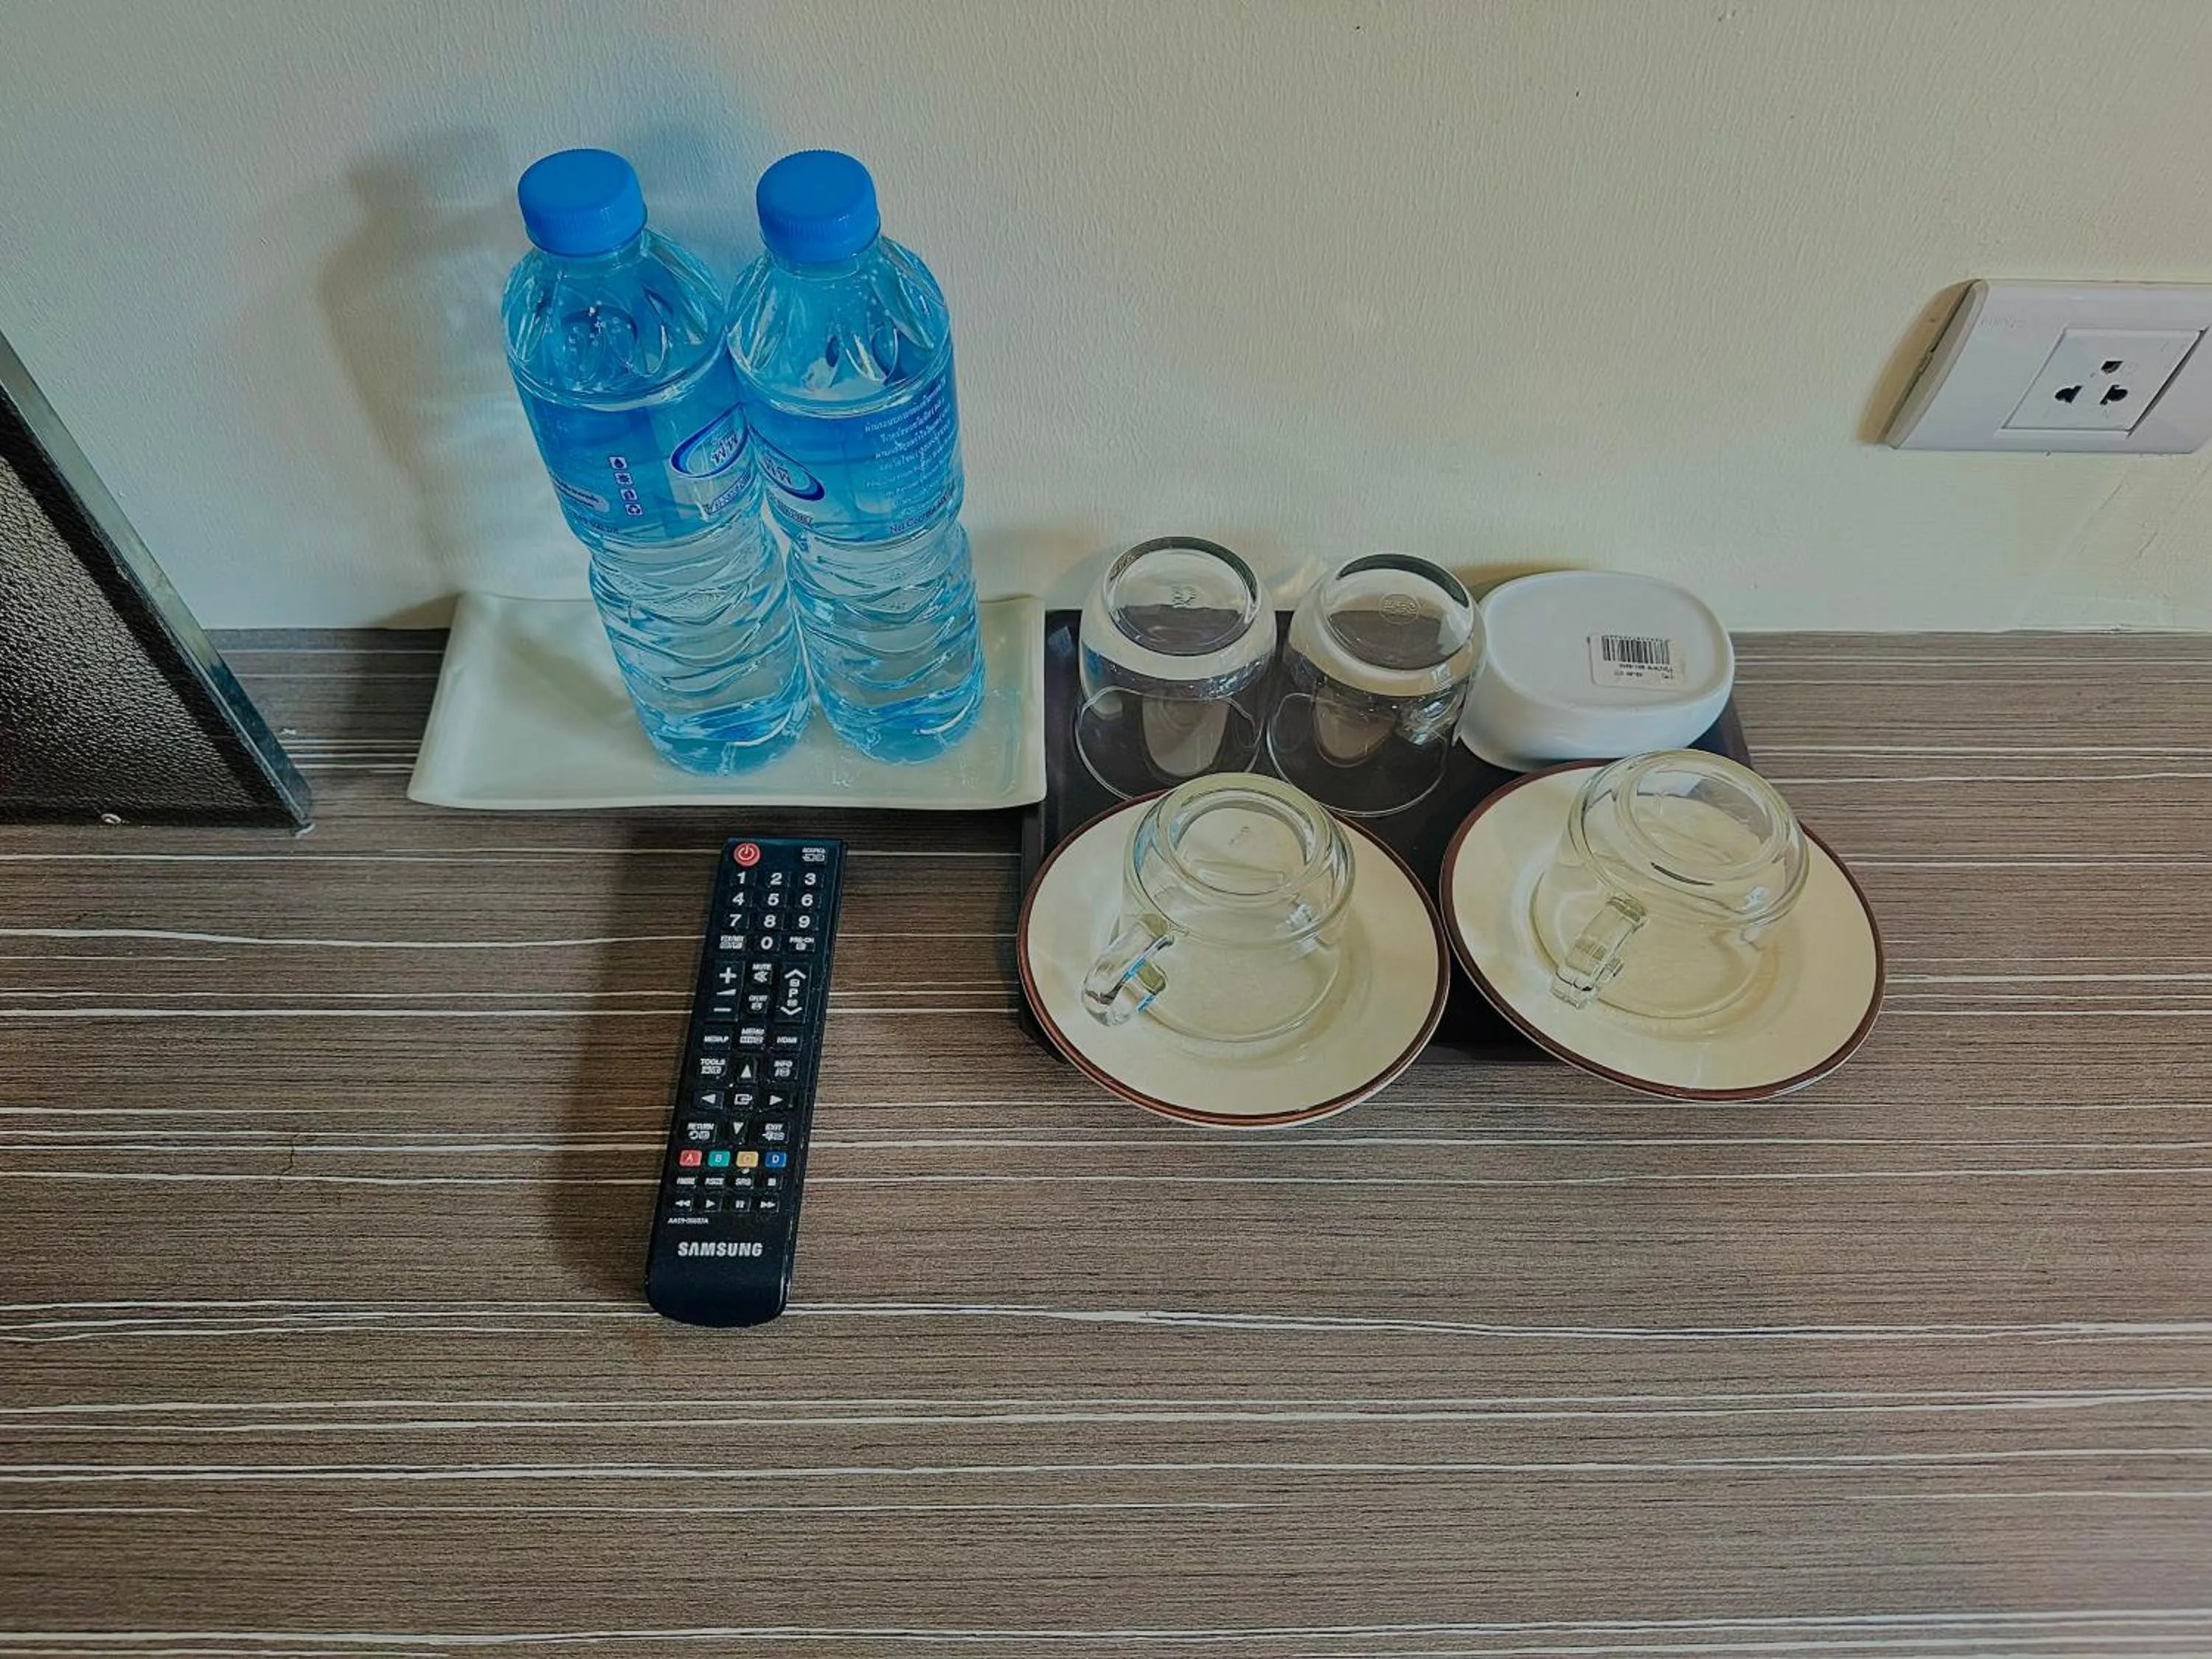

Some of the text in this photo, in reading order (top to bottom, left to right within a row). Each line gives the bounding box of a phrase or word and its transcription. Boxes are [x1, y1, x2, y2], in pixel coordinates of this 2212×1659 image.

[737, 872, 745, 884] 1
[770, 872, 782, 885] 2
[804, 873, 816, 885] 3
[732, 892, 745, 905] 4
[768, 893, 779, 906] 5
[801, 894, 813, 906] 6
[729, 914, 742, 927] 7
[764, 914, 776, 928] 8
[799, 915, 810, 928] 9
[761, 936, 773, 950] 0
[788, 988, 799, 998] P
[687, 1122, 714, 1130] RETURN
[686, 1154, 694, 1163] A
[714, 1154, 722, 1163] B
[772, 1155, 779, 1163] D
[678, 1242, 763, 1257] SAMSUNG
